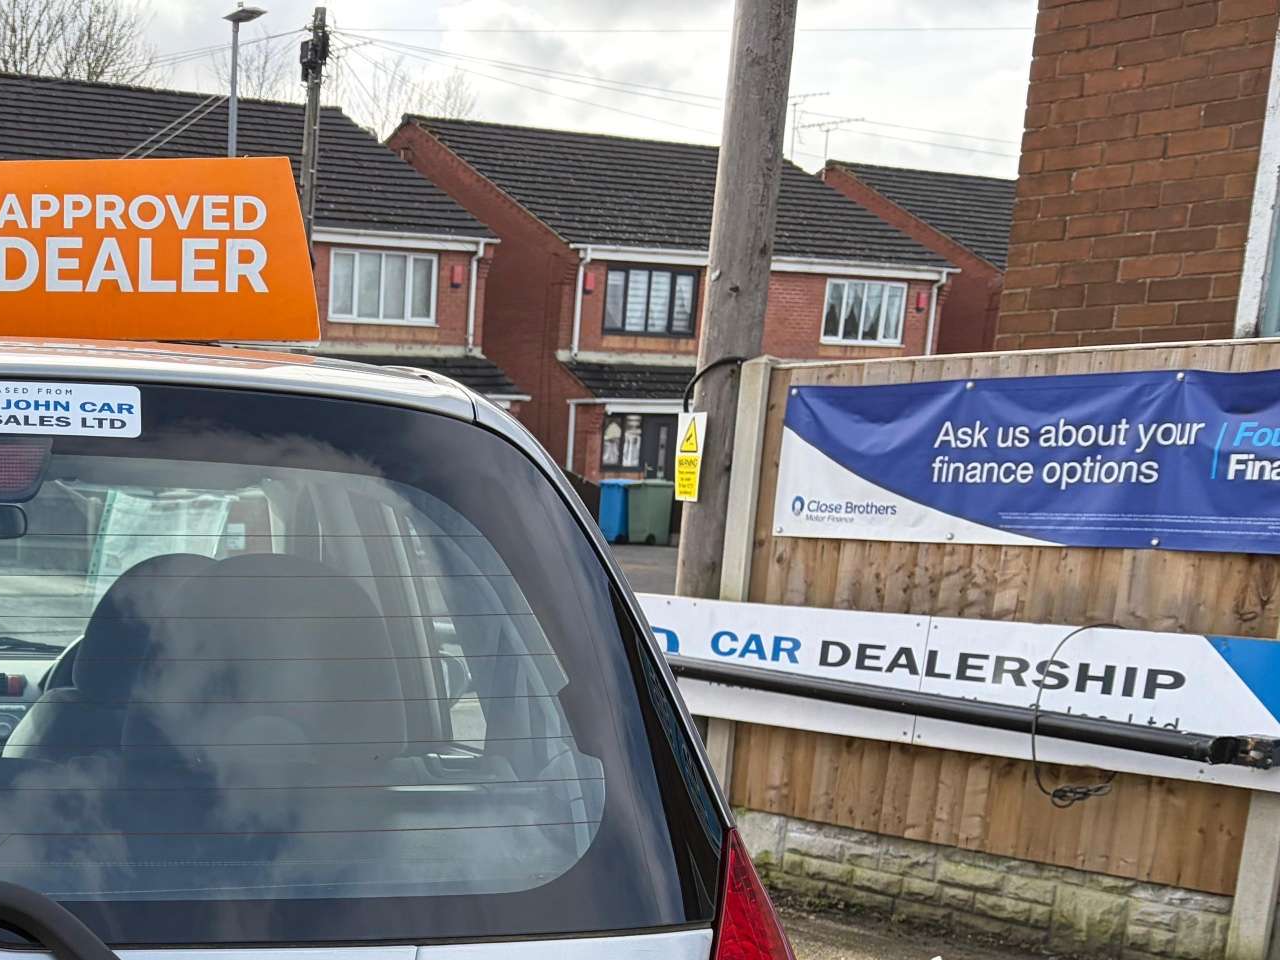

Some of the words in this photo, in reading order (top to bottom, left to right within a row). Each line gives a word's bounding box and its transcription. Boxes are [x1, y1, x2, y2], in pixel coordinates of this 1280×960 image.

[37, 388, 73, 396] FROM
[1, 399, 71, 412] JOHN
[79, 402, 135, 415] CAR
[80, 417, 128, 430] LTD
[934, 420, 989, 448] Ask
[997, 425, 1030, 448] us
[1038, 418, 1130, 448] about
[1135, 421, 1205, 454] your
[931, 456, 1034, 484] finance
[1042, 459, 1159, 490] options
[807, 500, 842, 514] Close
[845, 501, 897, 515] Brothers
[711, 631, 802, 664] CAR
[819, 640, 1186, 699] DEALERSHIP
